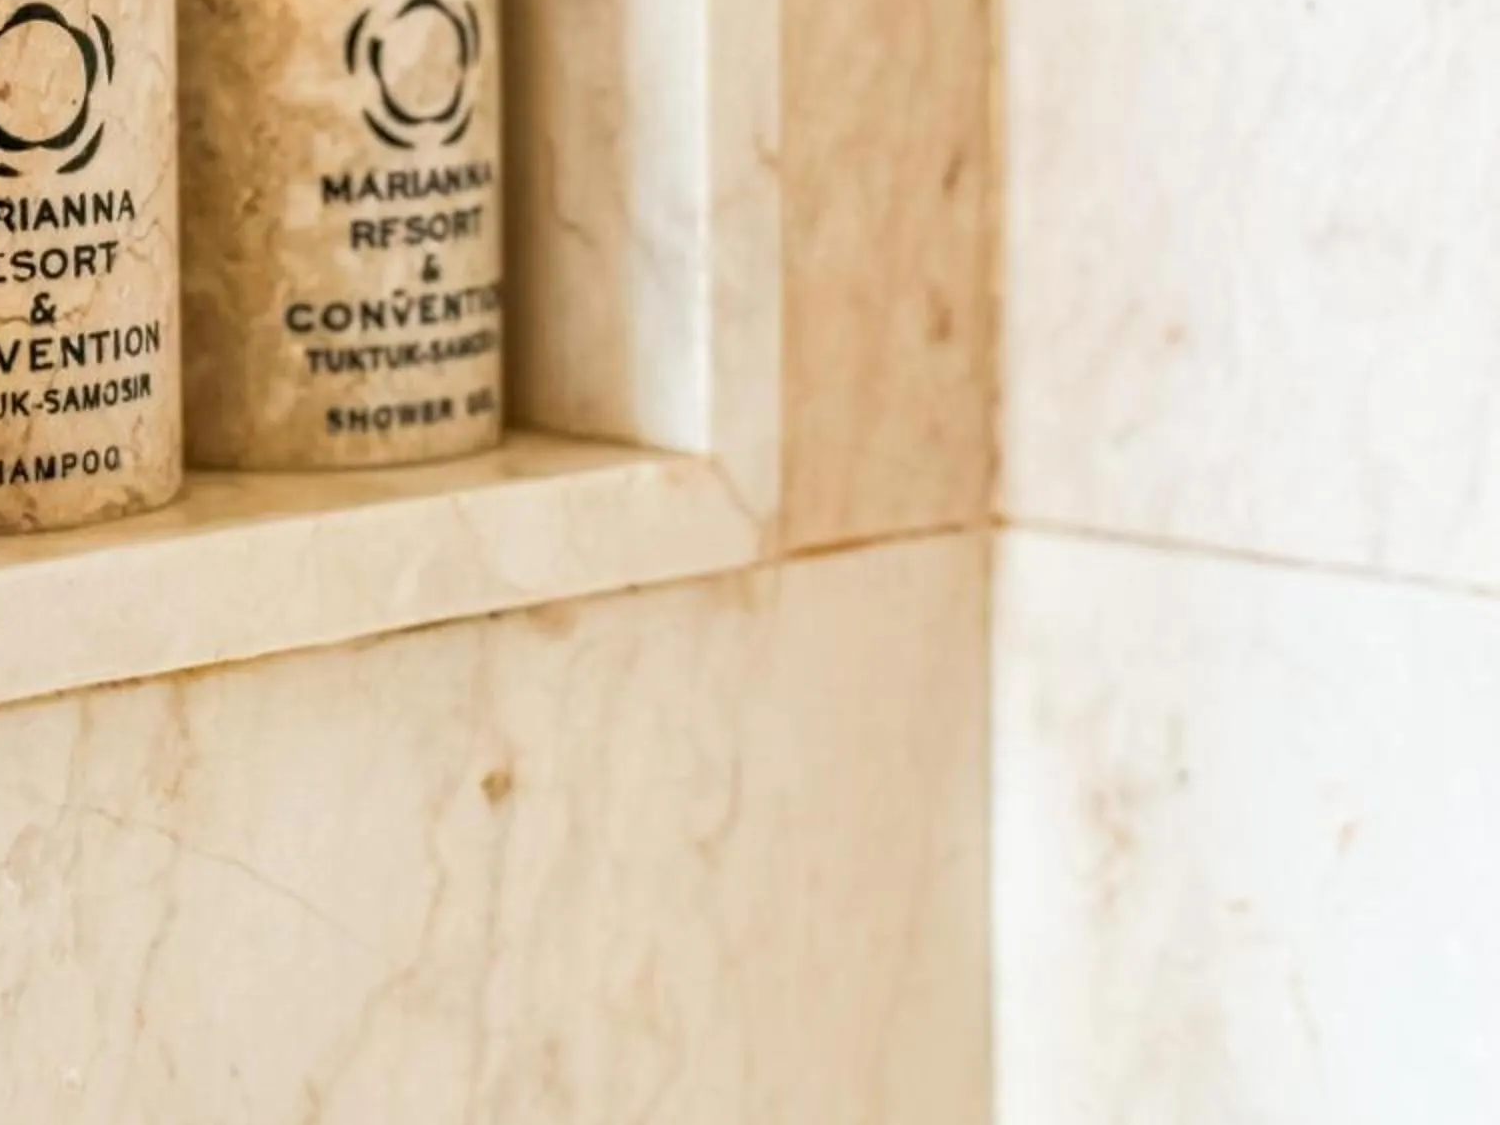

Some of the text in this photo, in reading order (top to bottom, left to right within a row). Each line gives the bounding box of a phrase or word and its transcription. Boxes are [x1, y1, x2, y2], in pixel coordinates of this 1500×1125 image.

[420, 254, 440, 282] &
[31, 293, 56, 324] &
[326, 398, 453, 433] SHOWER
